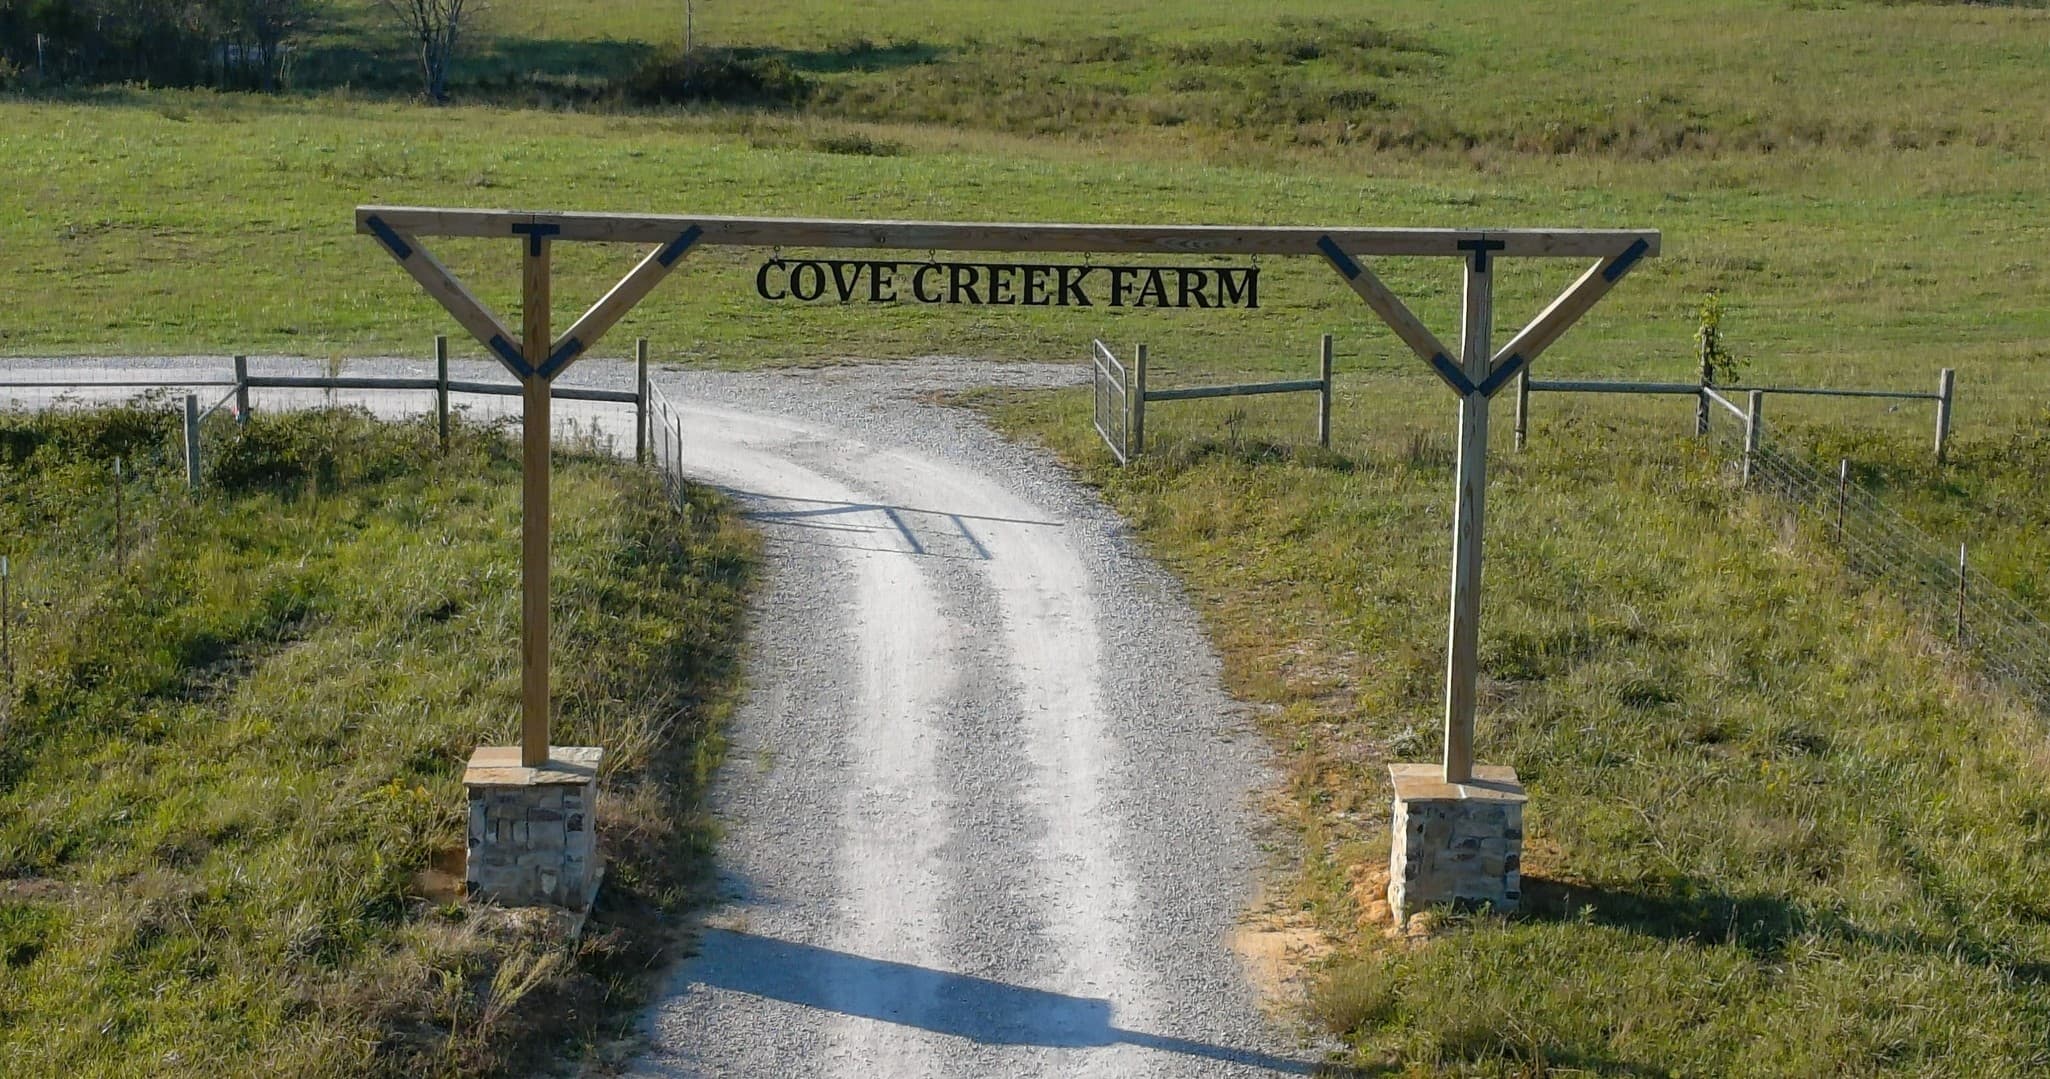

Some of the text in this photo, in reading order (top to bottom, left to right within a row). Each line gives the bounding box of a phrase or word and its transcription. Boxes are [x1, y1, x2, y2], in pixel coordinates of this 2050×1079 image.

[756, 261, 1260, 309] COVE CREEK FARM
